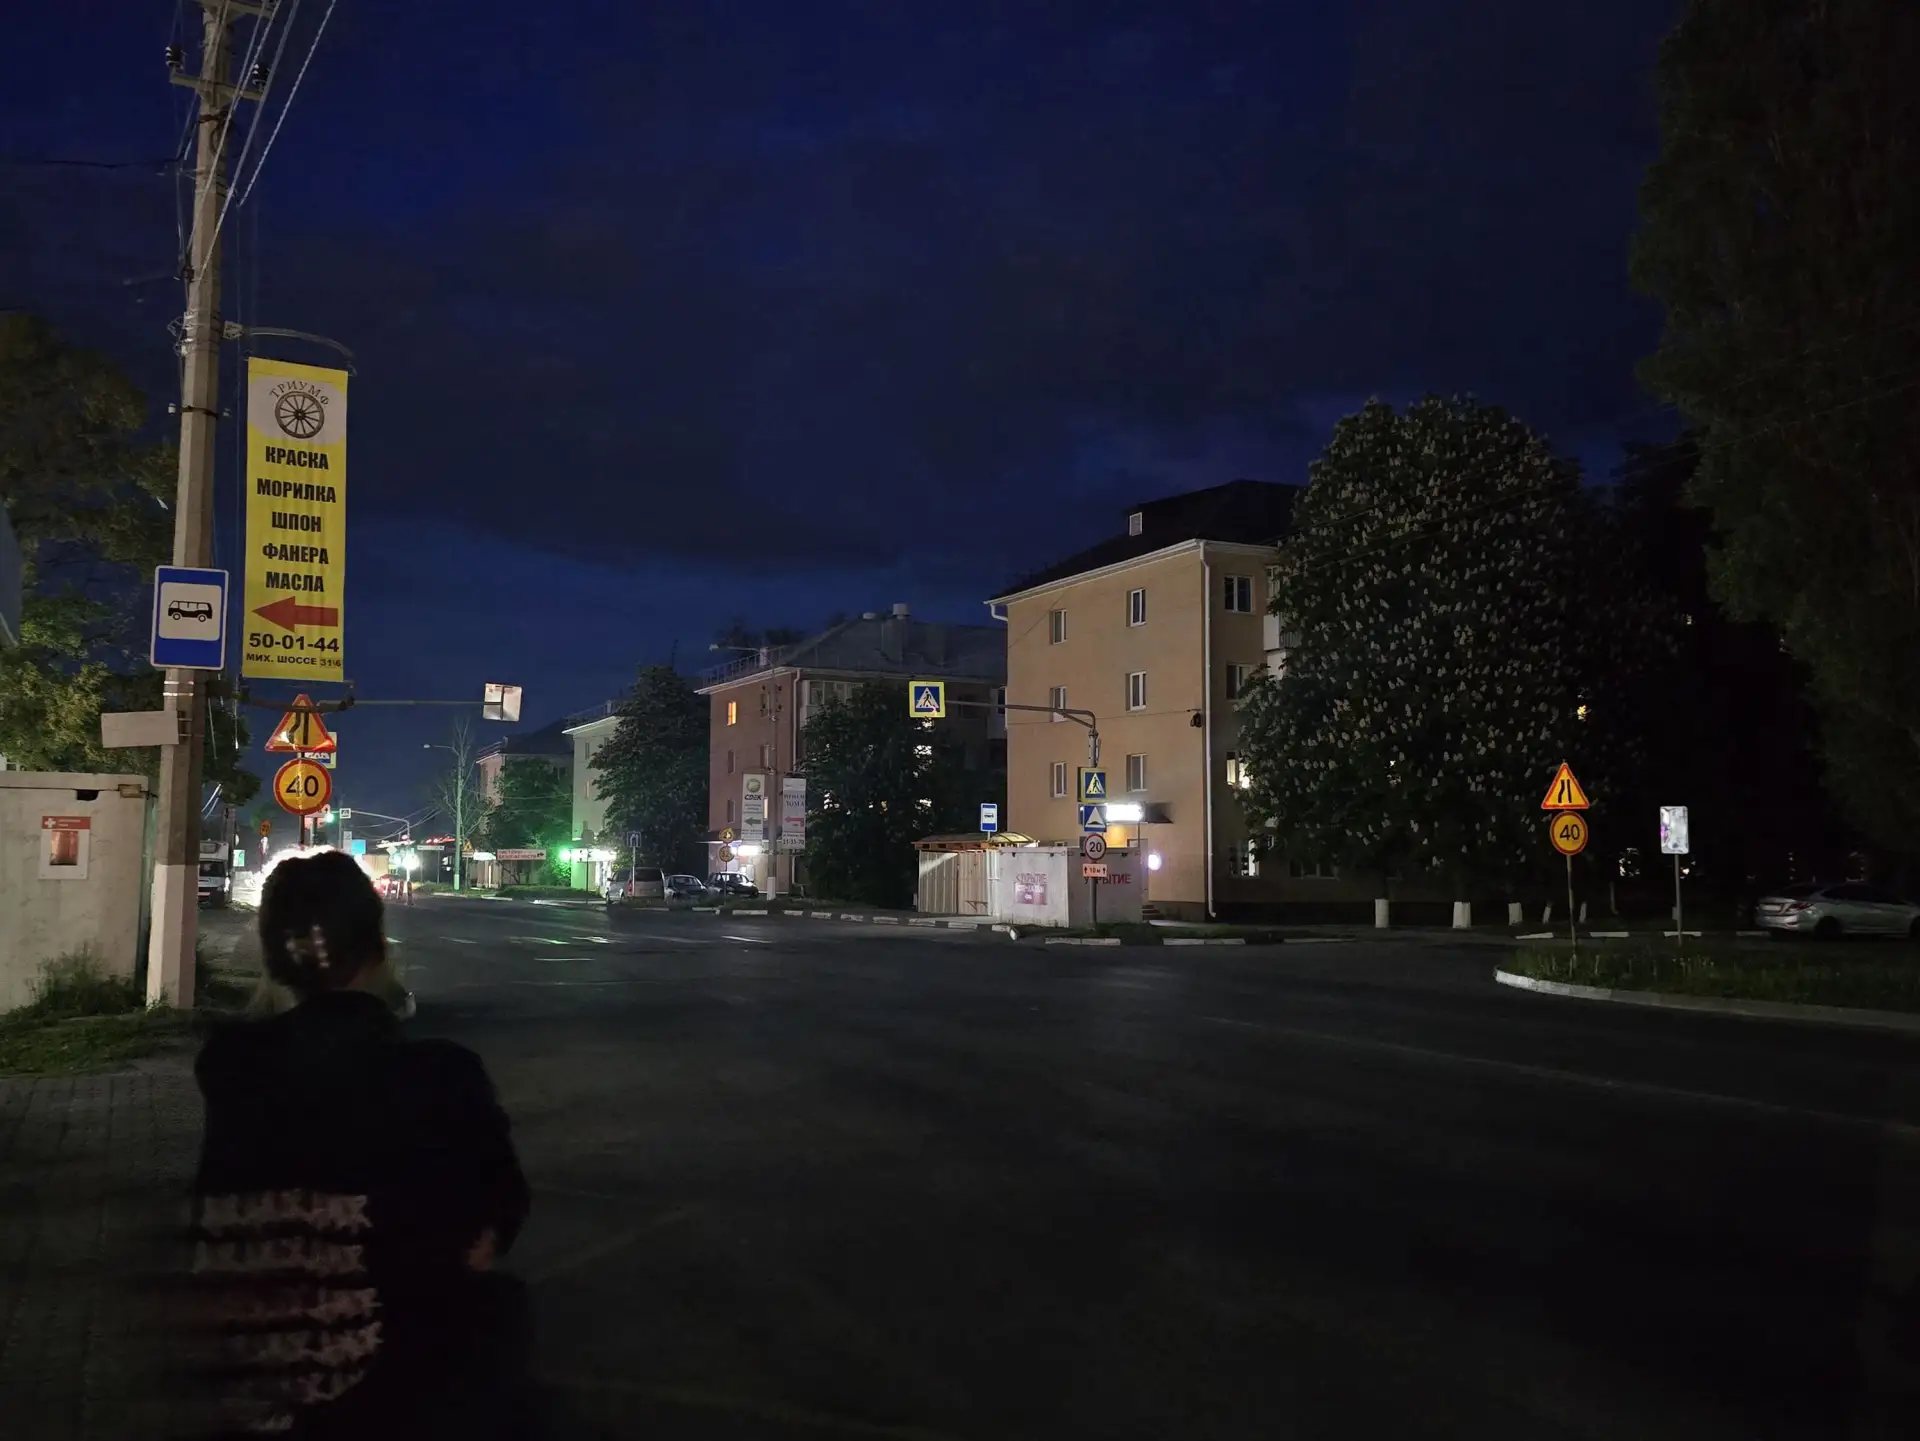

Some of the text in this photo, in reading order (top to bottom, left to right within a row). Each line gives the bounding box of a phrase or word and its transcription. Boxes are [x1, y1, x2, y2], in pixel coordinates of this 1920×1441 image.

[269, 380, 330, 406] ТРИУМФ
[265, 446, 329, 470] КРАСКА
[256, 478, 336, 504] МОРИЛКА
[271, 511, 321, 533] ШПОН
[262, 543, 329, 565] ФАНЕРА
[265, 571, 325, 593] МАСЛА
[249, 632, 340, 653] 50-01-44
[246, 653, 274, 663] МИХ.
[277, 655, 317, 665] ШОССЕ
[286, 775, 319, 797] 40
[1560, 824, 1580, 840] 40
[1089, 841, 1102, 853] 20
